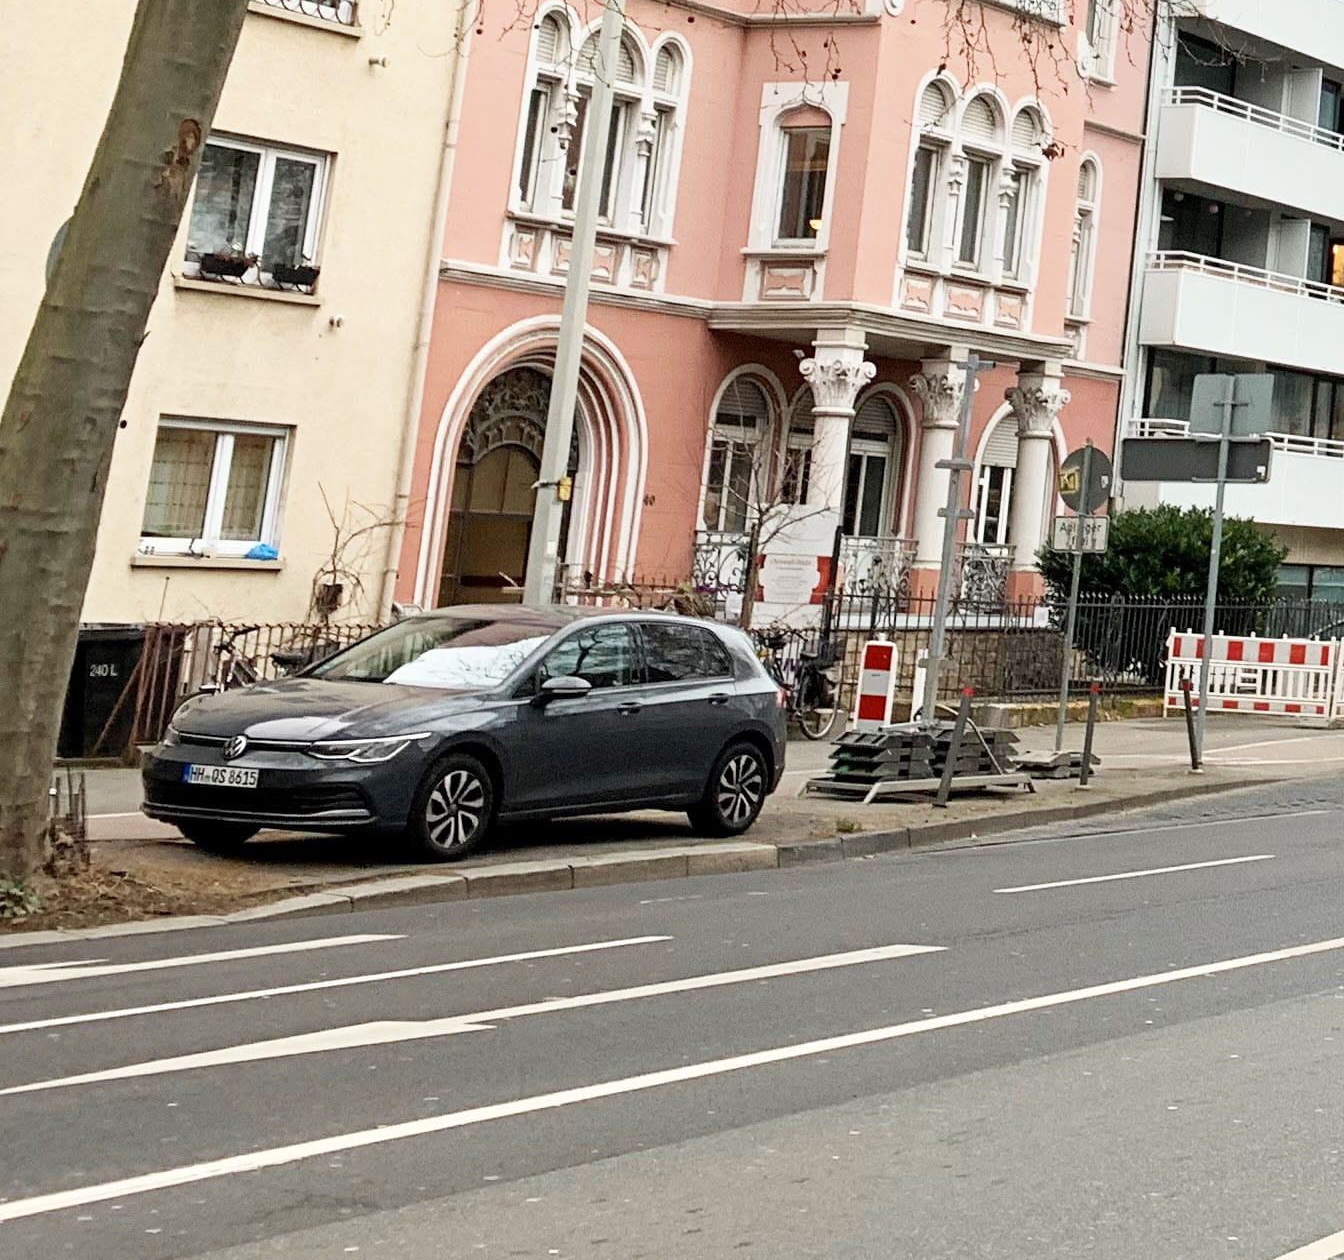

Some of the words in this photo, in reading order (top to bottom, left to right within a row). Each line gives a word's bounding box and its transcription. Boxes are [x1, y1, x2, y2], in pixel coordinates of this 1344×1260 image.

[90, 664, 109, 677] 240
[110, 664, 118, 677] L
[228, 770, 257, 786] 8615
